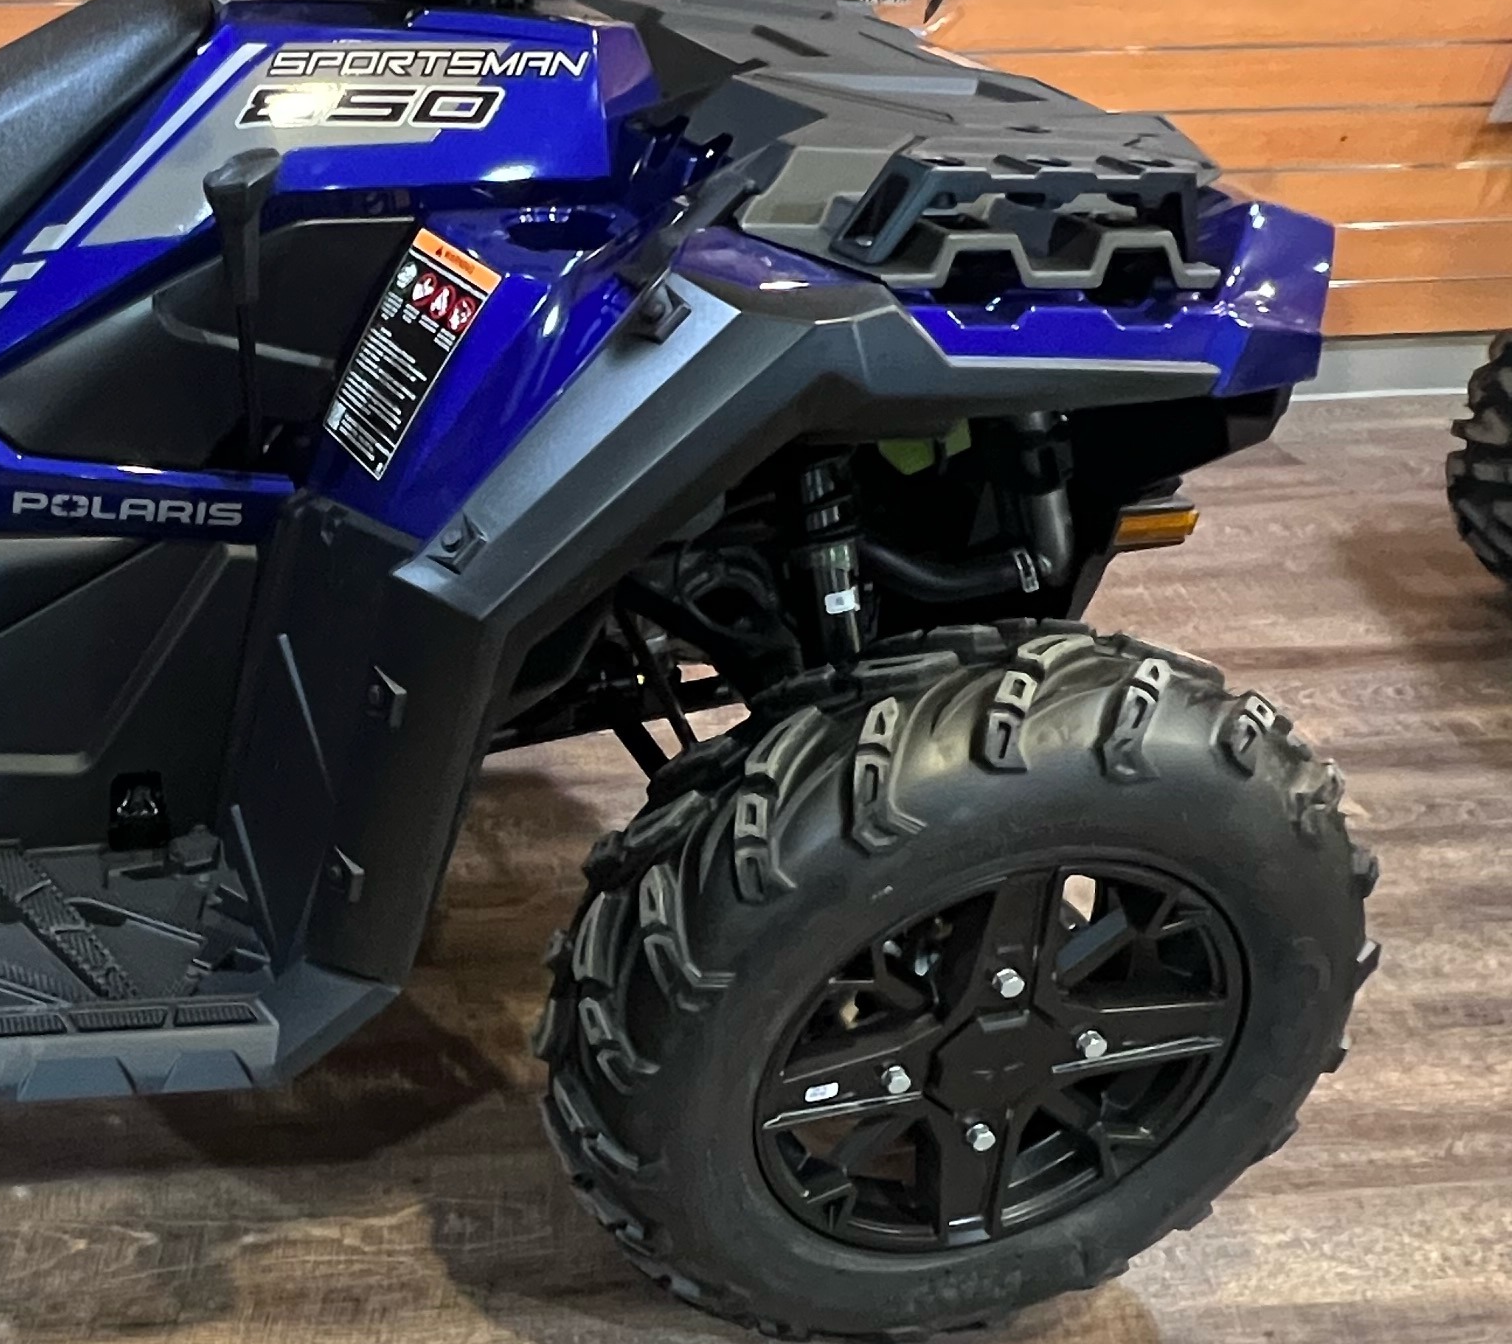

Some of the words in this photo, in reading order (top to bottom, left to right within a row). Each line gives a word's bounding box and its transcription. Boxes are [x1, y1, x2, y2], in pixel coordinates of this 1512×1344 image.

[267, 48, 591, 78] SPORTSMAN
[235, 84, 506, 130] 850
[11, 491, 244, 527] POLARIS
